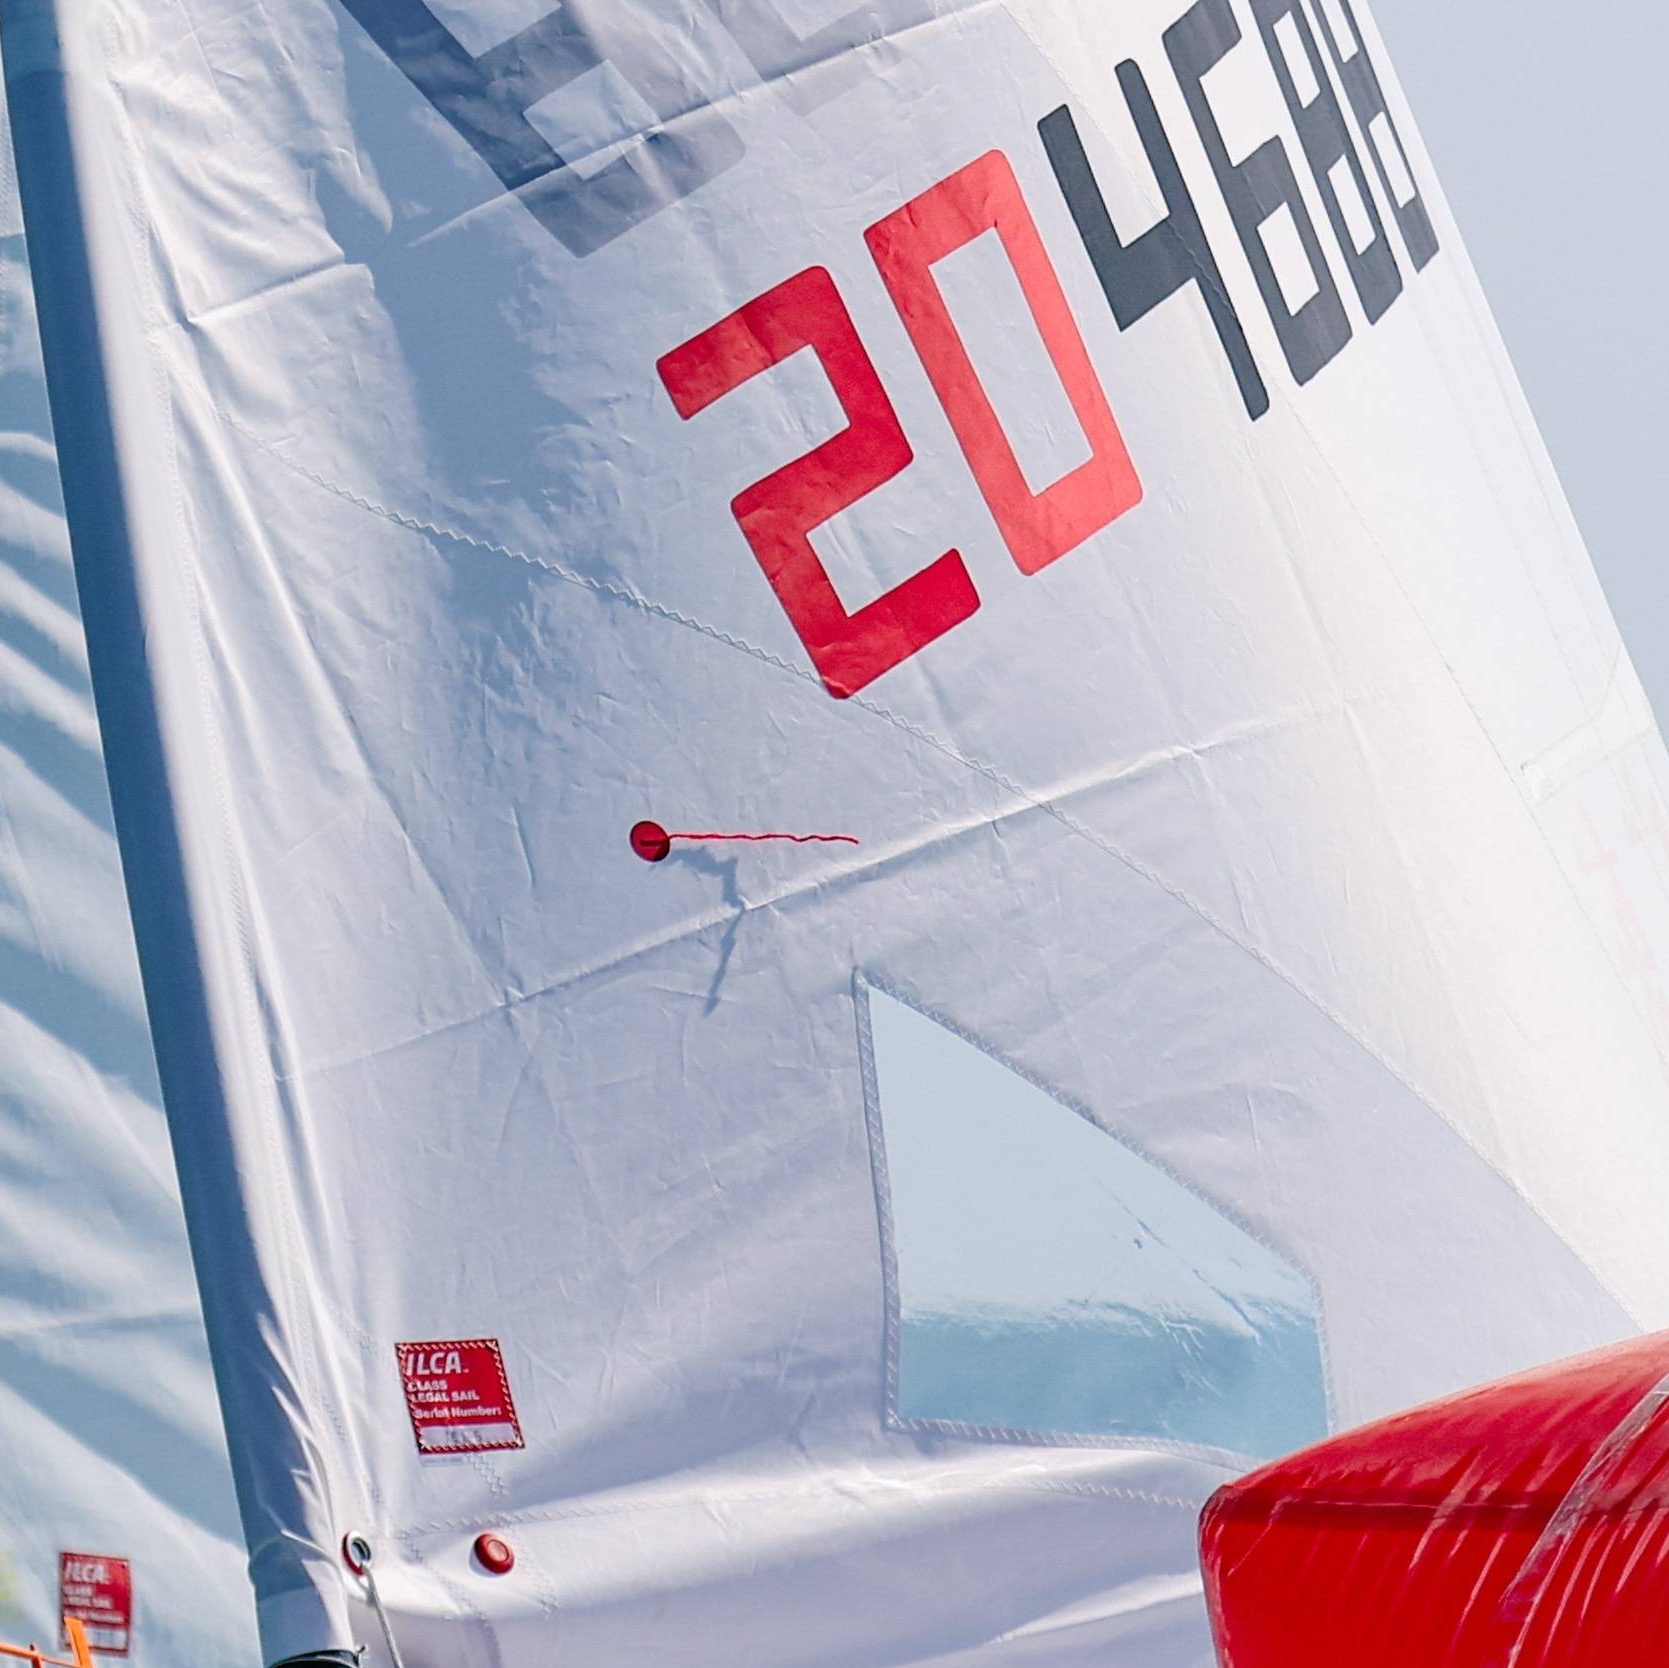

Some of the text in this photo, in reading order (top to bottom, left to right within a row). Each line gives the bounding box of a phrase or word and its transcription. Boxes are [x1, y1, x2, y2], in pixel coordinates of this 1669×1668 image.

[405, 1351, 462, 1376] ILCA
[407, 1379, 448, 1393] CLASS
[408, 1389, 480, 1403] LEGAL SAIL
